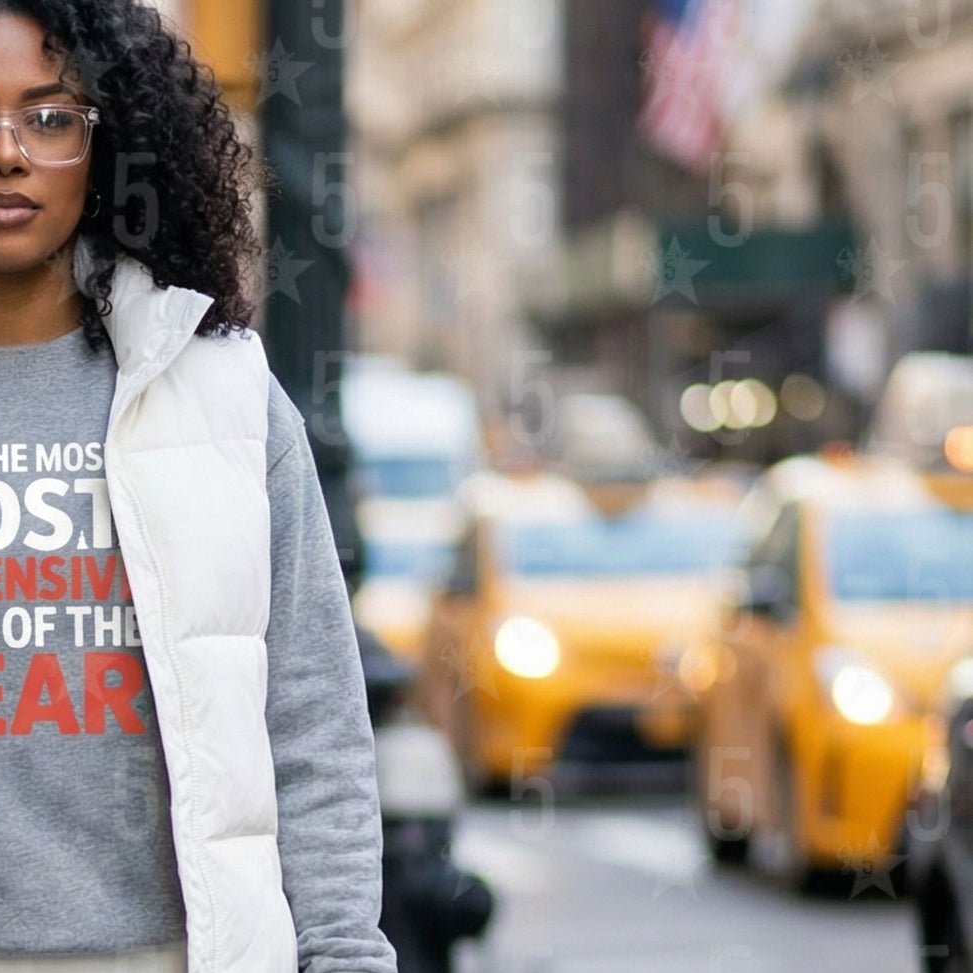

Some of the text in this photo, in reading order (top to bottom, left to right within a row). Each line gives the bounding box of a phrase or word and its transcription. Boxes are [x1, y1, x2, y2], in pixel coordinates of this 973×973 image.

[36, 442, 106, 472] MOS
[2, 606, 58, 649] OF
[65, 605, 143, 648] THE
